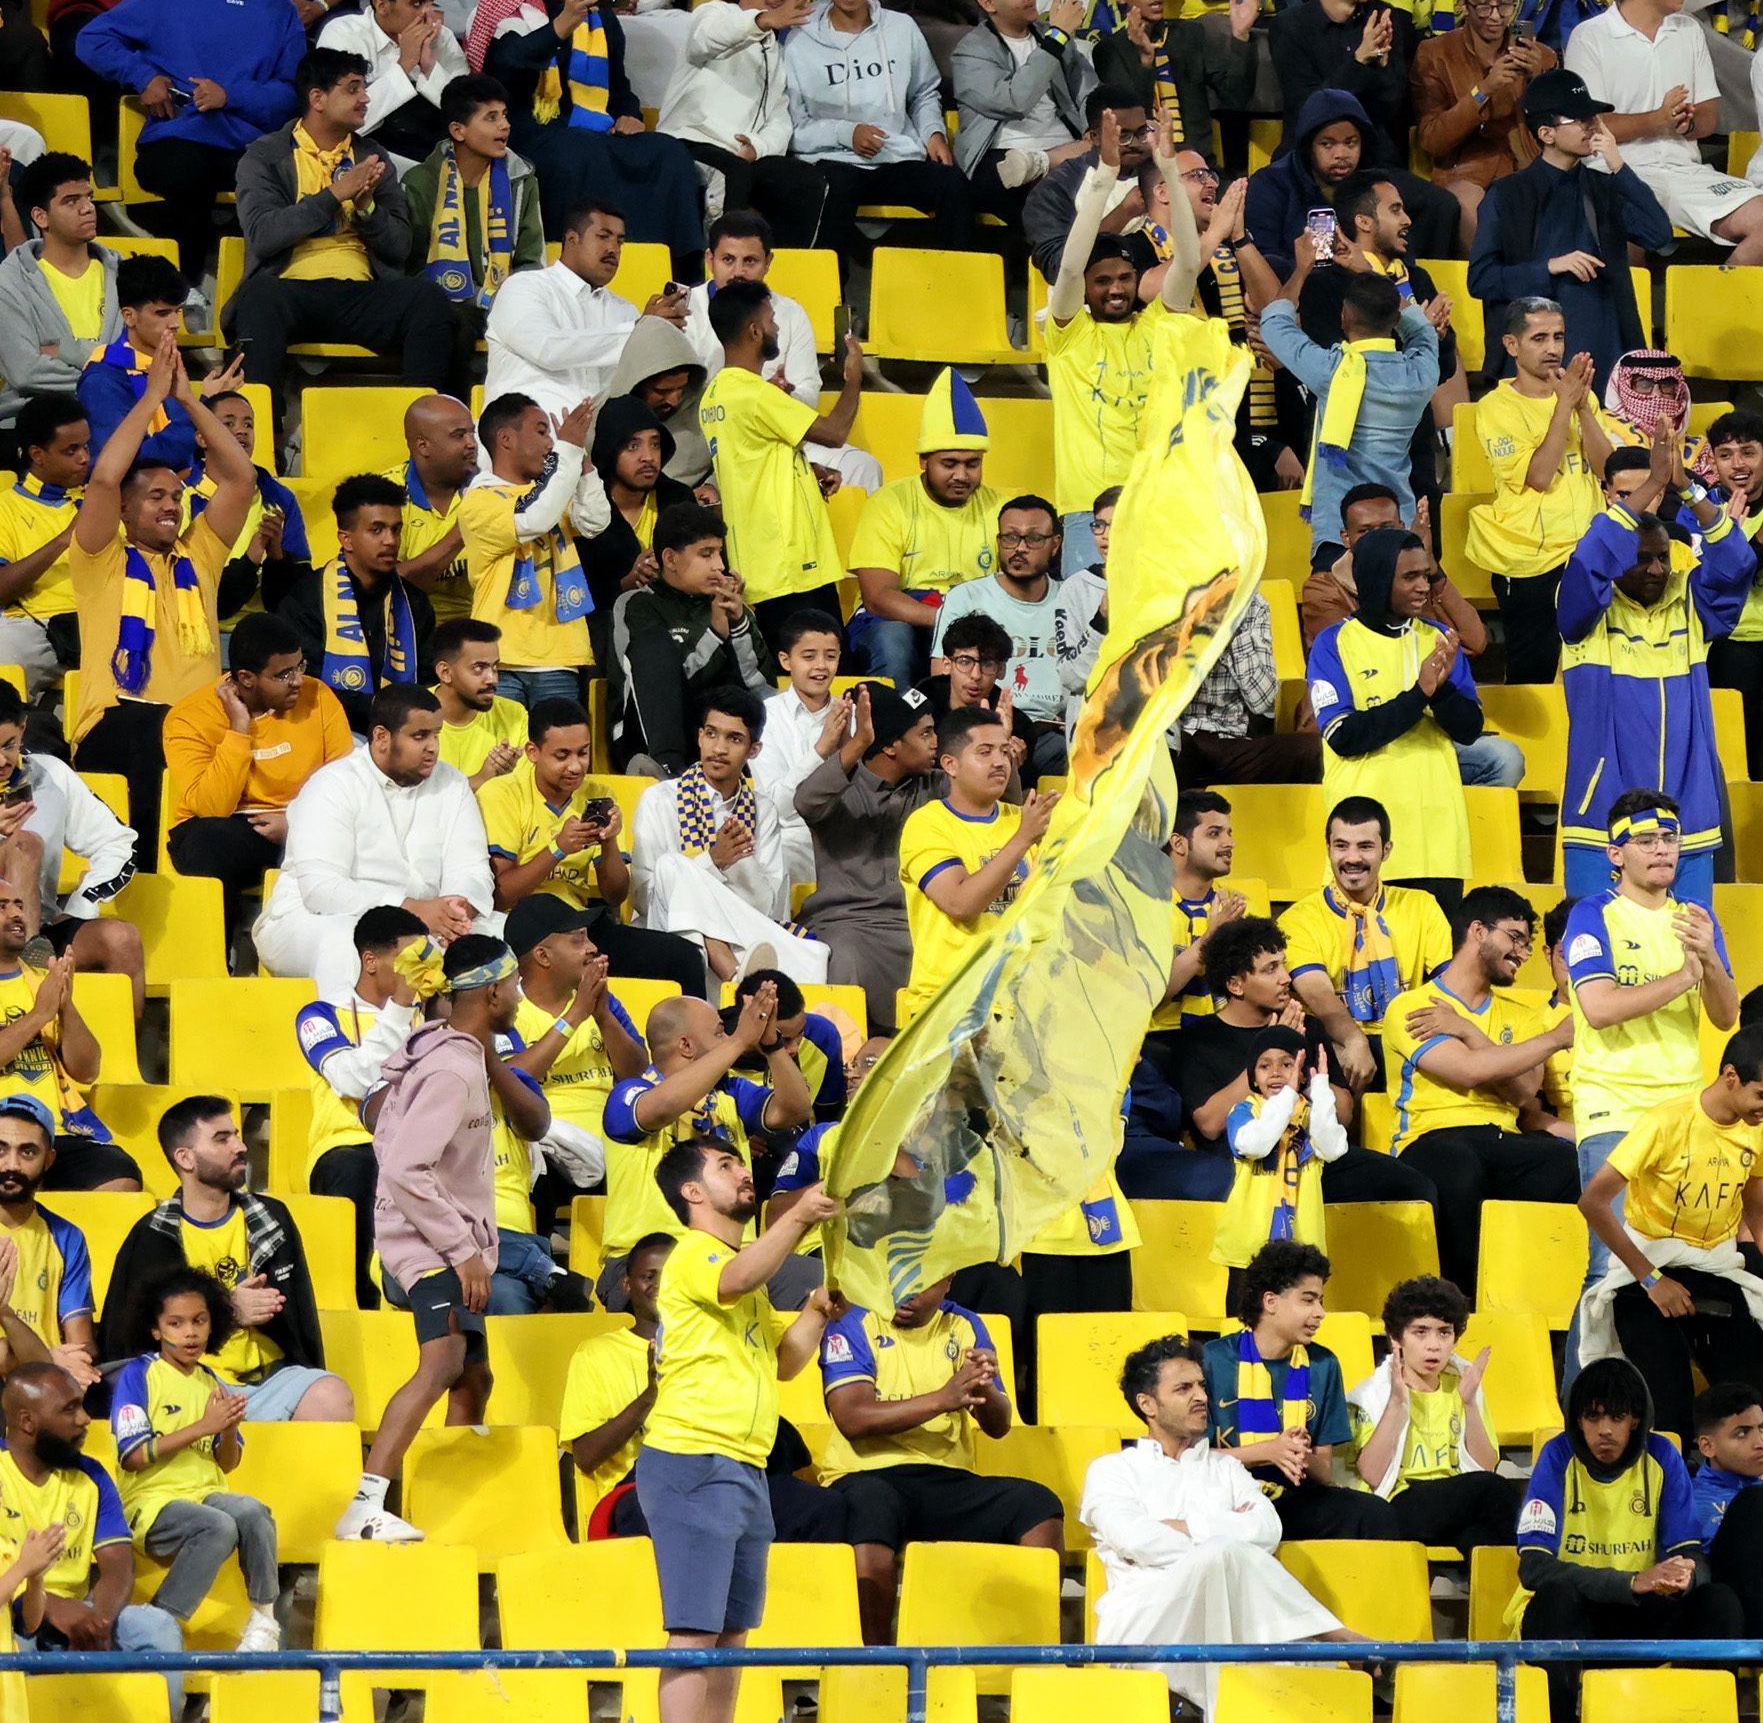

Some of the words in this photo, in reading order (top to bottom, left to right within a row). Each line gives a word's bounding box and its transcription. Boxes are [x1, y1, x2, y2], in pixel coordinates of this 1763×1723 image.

[825, 59, 897, 87] Dior
[552, 1066, 614, 1085] SHURFAH
[1588, 1539, 1653, 1556] SHURFAH
